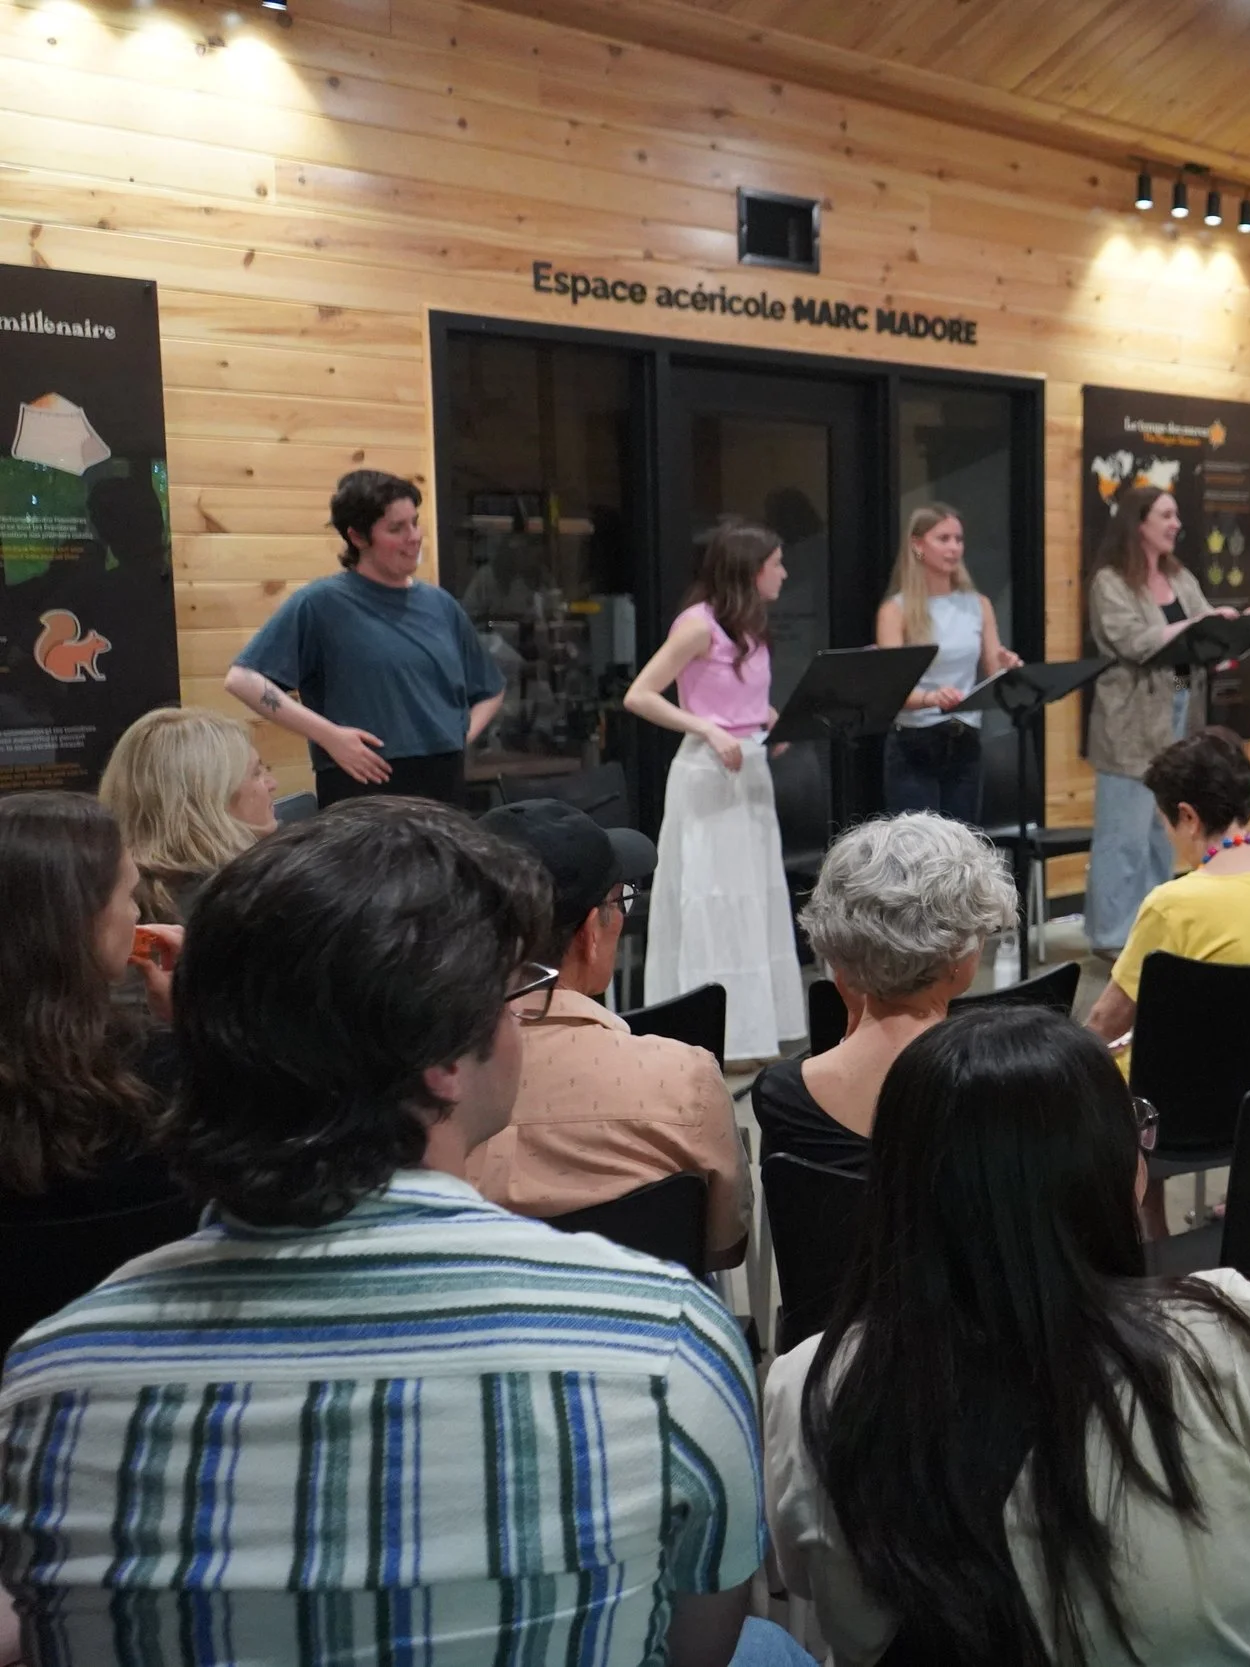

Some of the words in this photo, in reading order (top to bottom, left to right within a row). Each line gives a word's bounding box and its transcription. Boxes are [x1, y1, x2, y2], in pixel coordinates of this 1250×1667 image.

[533, 261, 647, 305] Espace
[655, 282, 785, 320] acéricole
[793, 296, 869, 331] MARC
[876, 308, 977, 345] MADORE
